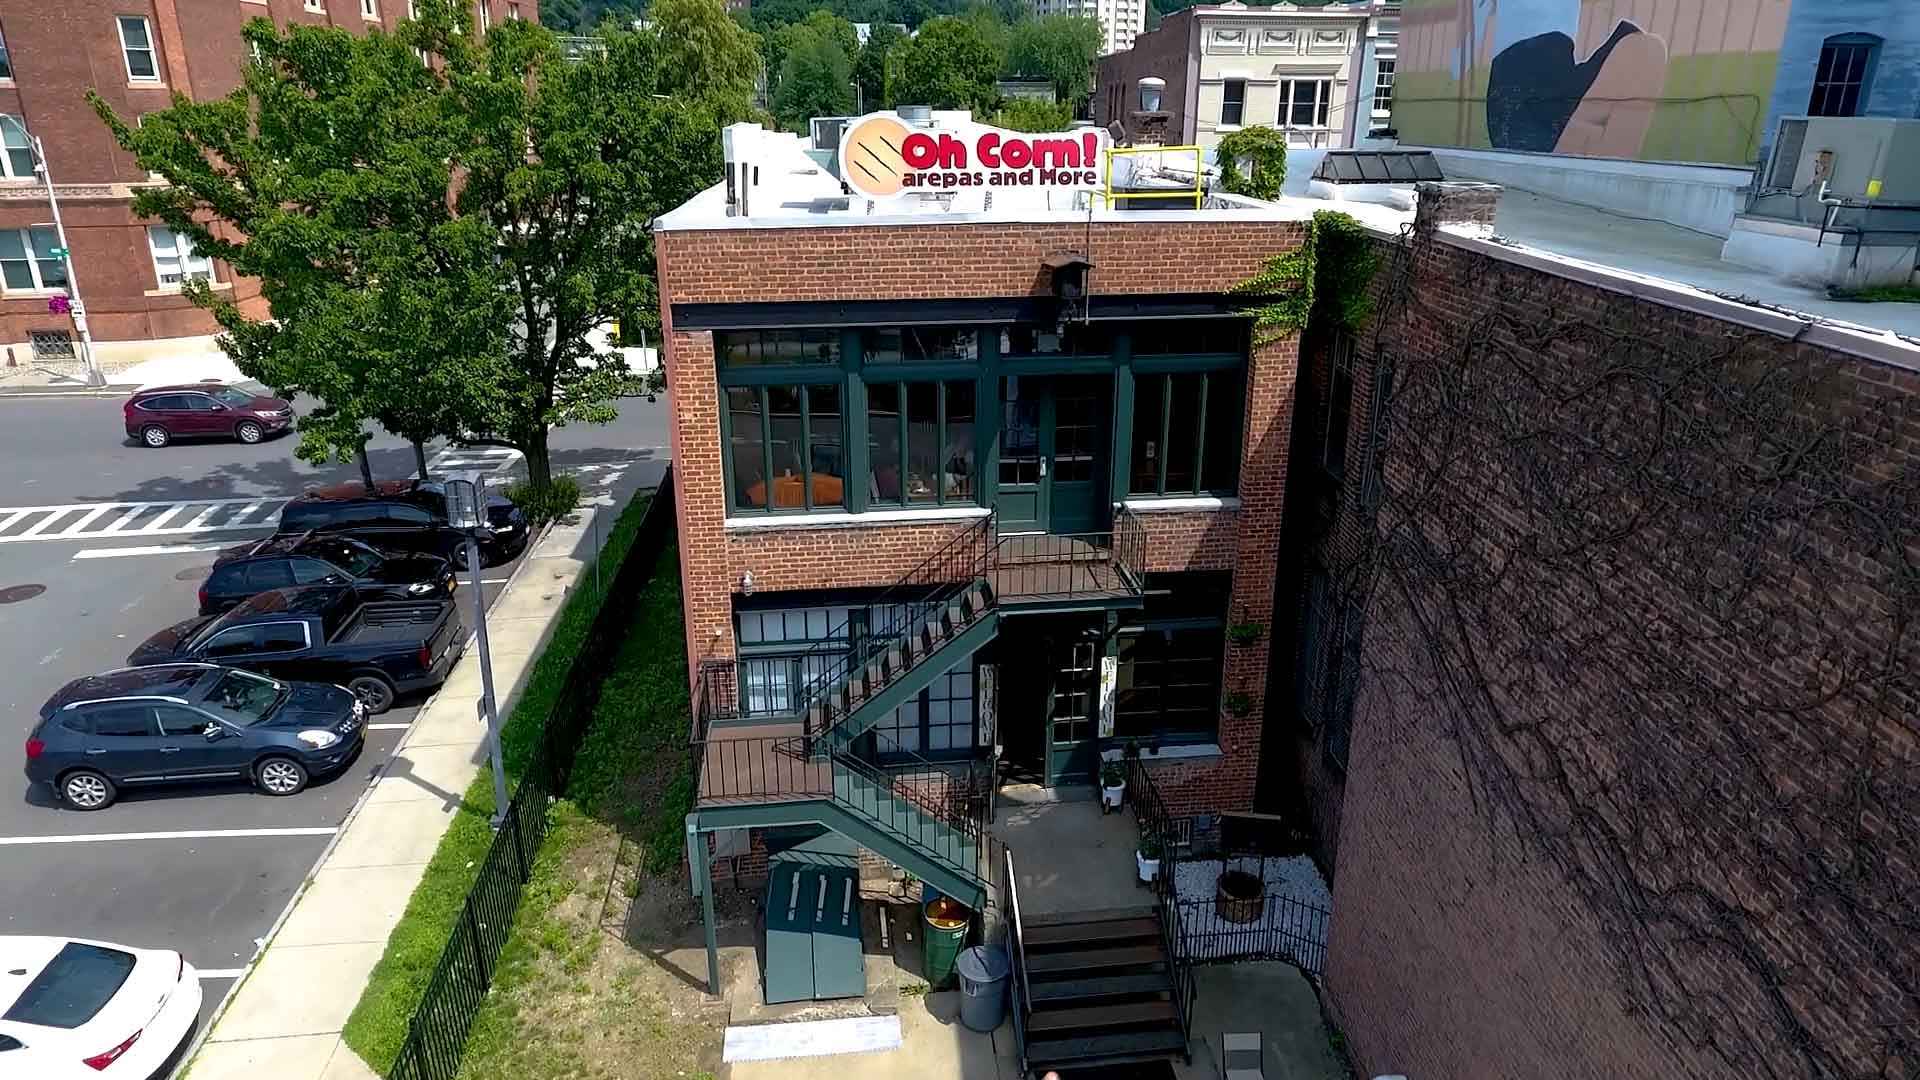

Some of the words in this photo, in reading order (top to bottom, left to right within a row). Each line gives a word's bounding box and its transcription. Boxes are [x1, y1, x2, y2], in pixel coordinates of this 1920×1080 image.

[902, 133, 967, 170] Oh
[976, 132, 1098, 169] Corn!
[902, 171, 984, 188] arepas
[988, 169, 1034, 186] and
[1039, 169, 1097, 186] More
